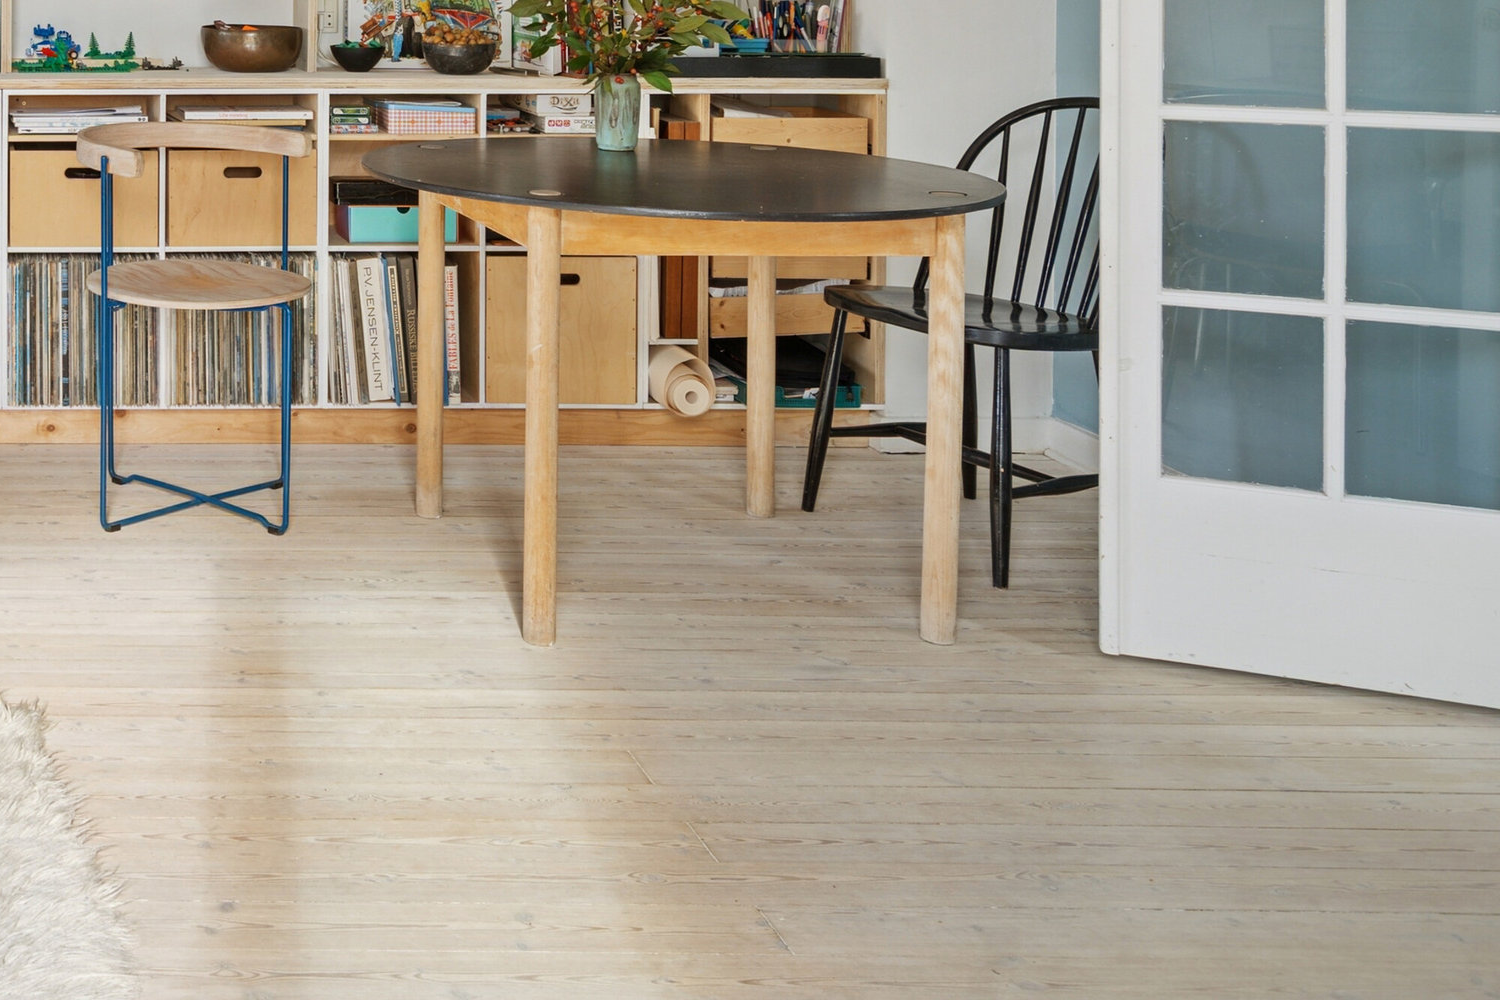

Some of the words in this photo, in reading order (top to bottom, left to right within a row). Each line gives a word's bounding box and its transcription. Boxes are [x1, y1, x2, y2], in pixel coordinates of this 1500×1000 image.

[363, 266, 373, 287] P.V.
[445, 271, 455, 313] Fontaine
[406, 310, 416, 350] RUSSISKE
[447, 314, 456, 322] La
[448, 322, 456, 330] de
[366, 290, 382, 390] JENSEN-KLINT
[448, 332, 458, 370] FABLES
